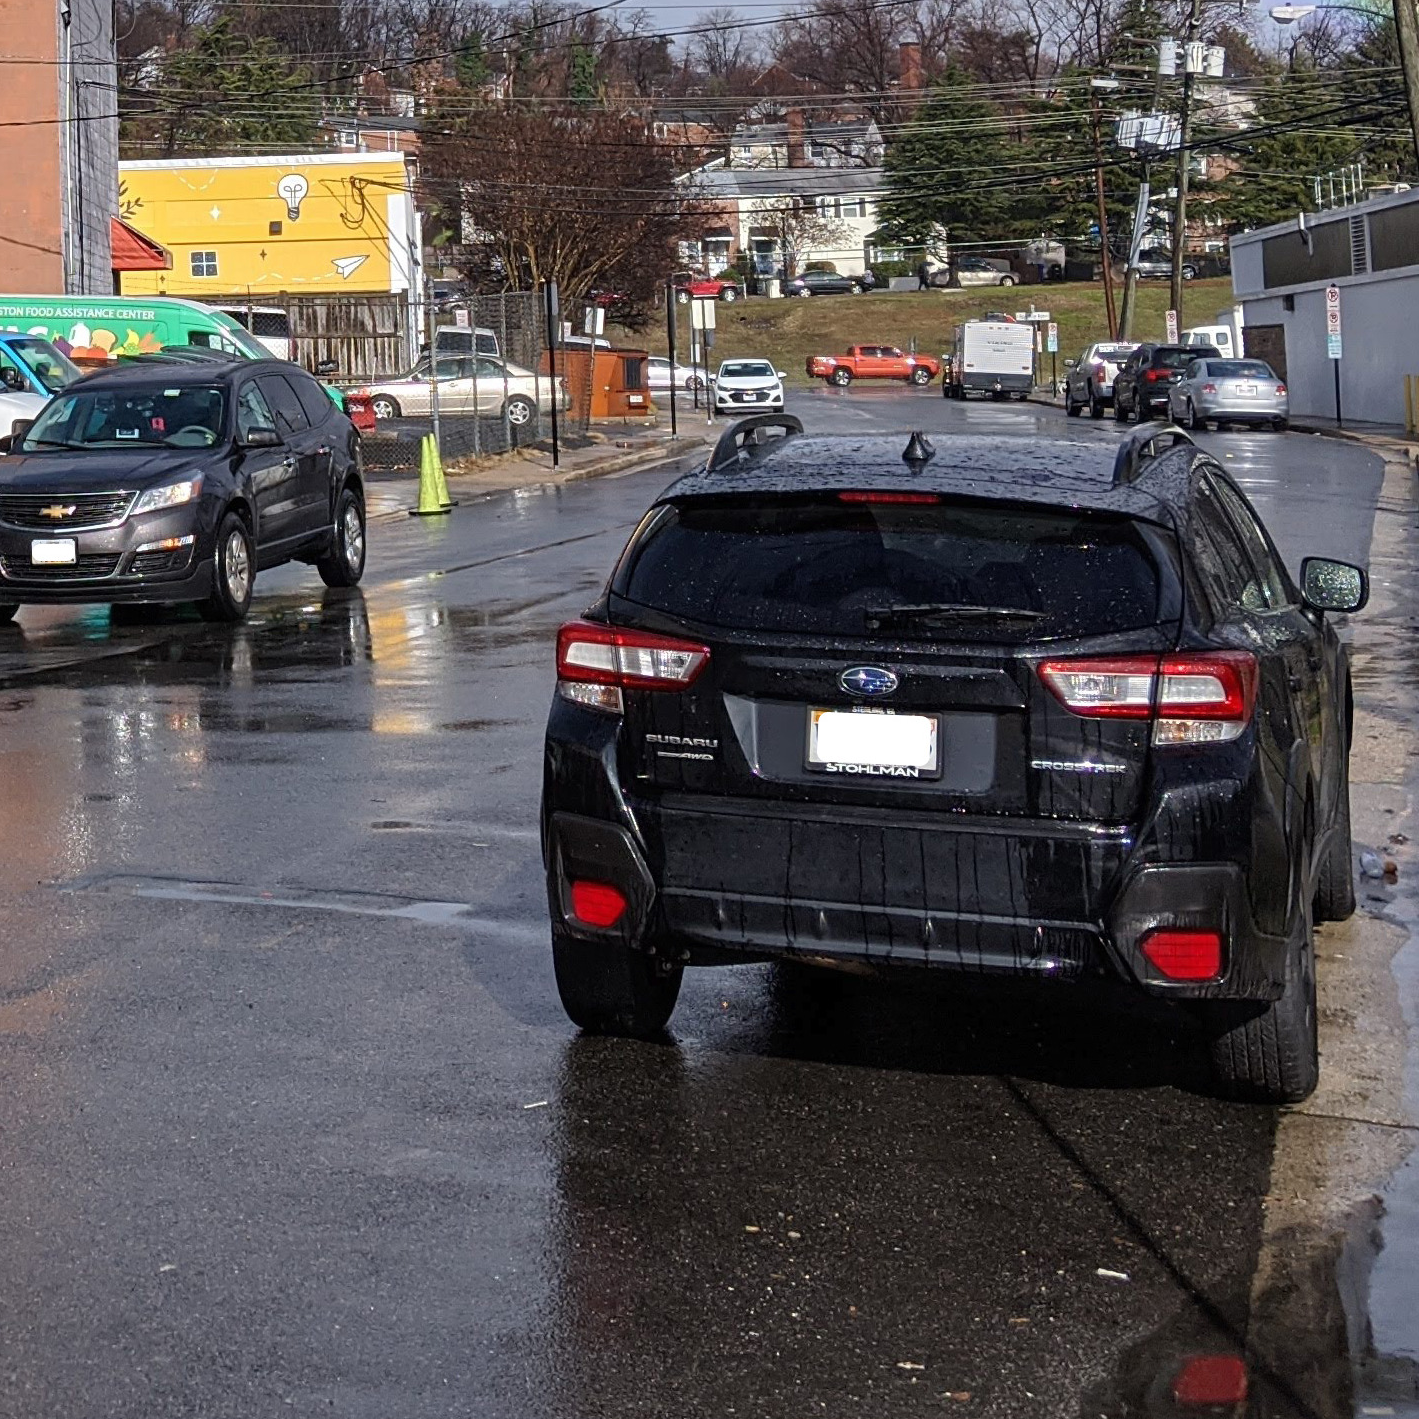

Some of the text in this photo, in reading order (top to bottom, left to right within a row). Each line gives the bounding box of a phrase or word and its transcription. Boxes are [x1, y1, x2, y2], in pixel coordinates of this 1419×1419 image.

[25, 306, 54, 317] FOOD
[54, 307, 115, 319] ASSISTANCE
[116, 309, 155, 320] CENTER
[645, 734, 718, 748] SUBARU
[826, 762, 919, 778] STOHLMAN
[1031, 760, 1126, 773] CROSSTREK
